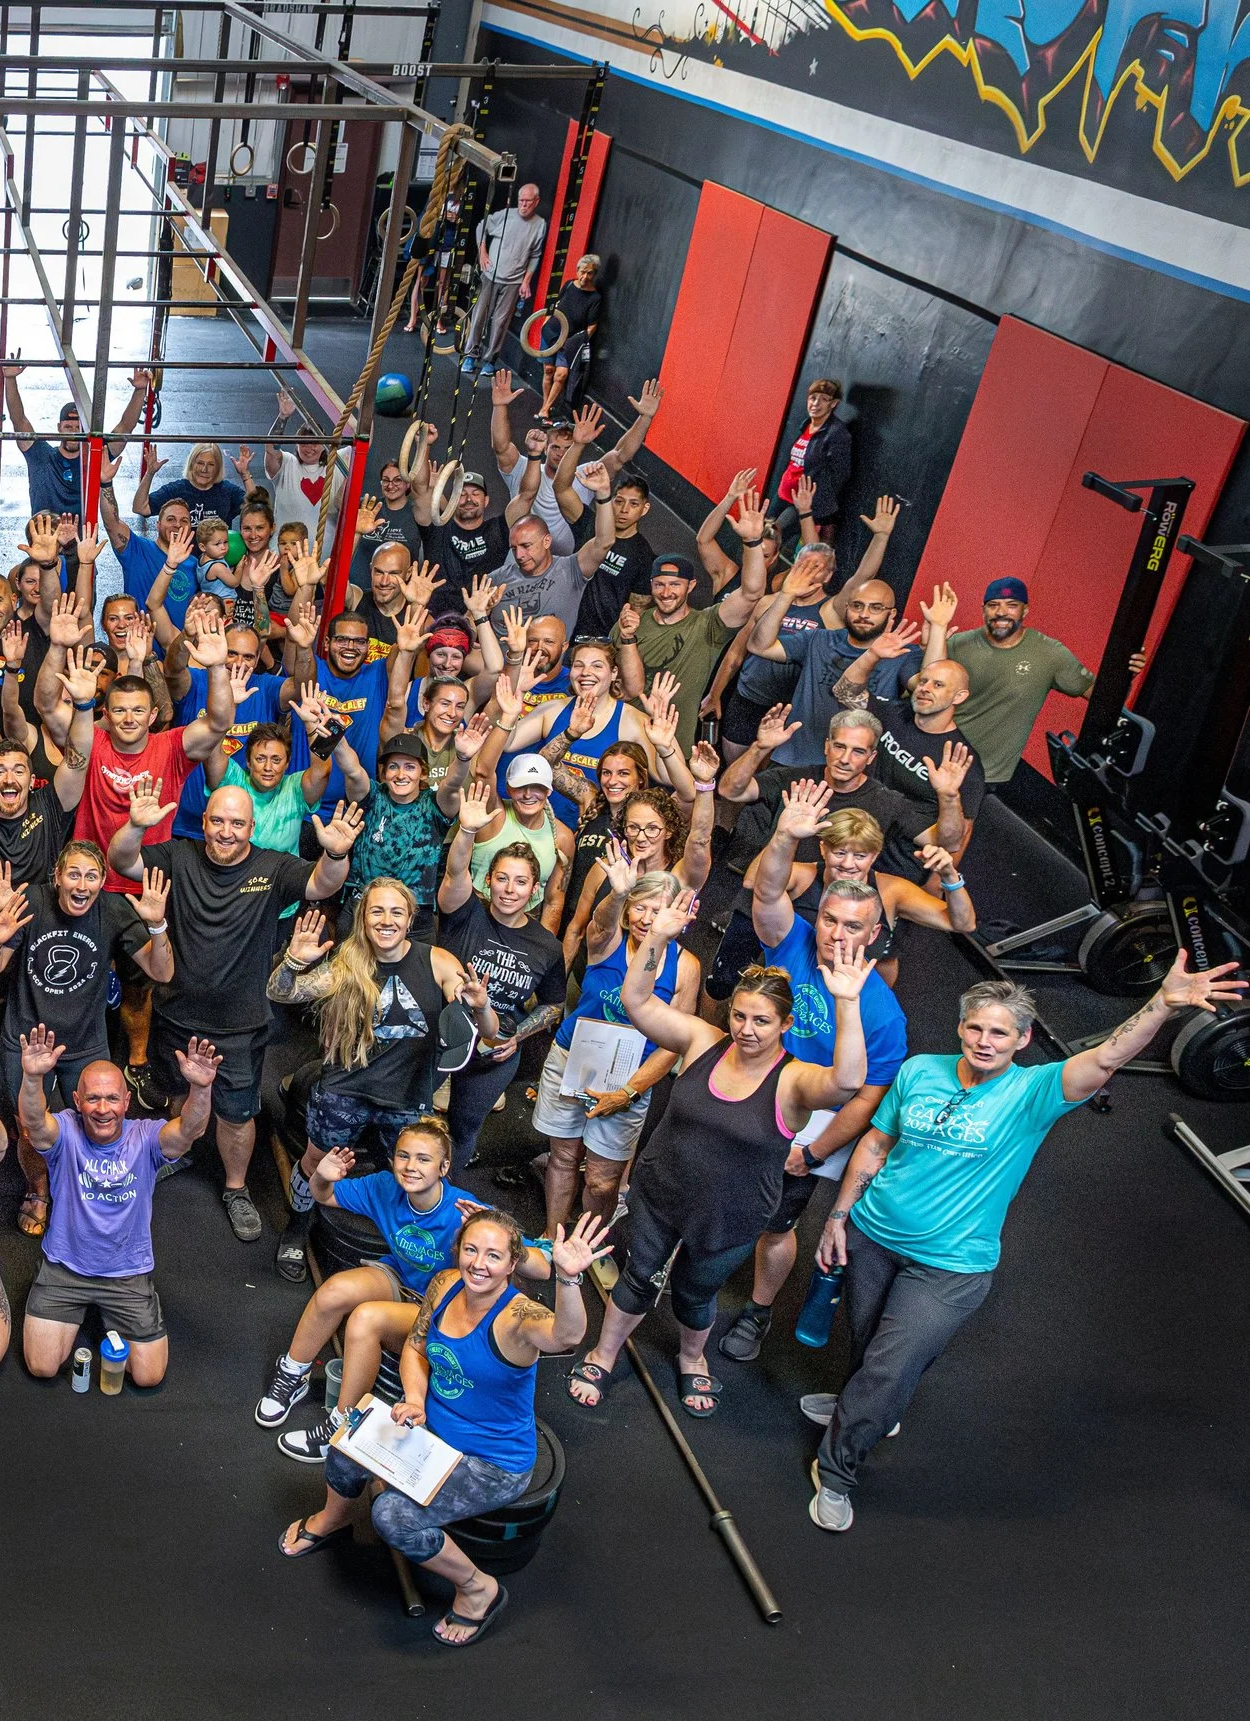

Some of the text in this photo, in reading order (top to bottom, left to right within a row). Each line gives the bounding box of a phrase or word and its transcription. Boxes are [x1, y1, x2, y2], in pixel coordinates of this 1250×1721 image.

[392, 64, 433, 77] BOOST
[1147, 501, 1178, 571] ROWERG
[605, 551, 627, 566] IVE
[571, 754, 599, 767] SCALE
[880, 730, 930, 781] ROGUE
[240, 883, 273, 894] WINNERS
[248, 876, 269, 886] SORE
[30, 930, 97, 952] BLACKFIT ENERGY
[1187, 915, 1211, 971] concep
[496, 949, 517, 969] THE
[471, 955, 533, 990] SHOWDOWN
[32, 974, 44, 987] CCF
[68, 978, 86, 992] 2024
[44, 986, 64, 995] OPEN
[903, 1118, 932, 1133] 2023
[932, 1123, 985, 1144] AGES
[84, 1159, 129, 1175] ALL CHALK
[81, 1189, 137, 1203] NO ACTION
